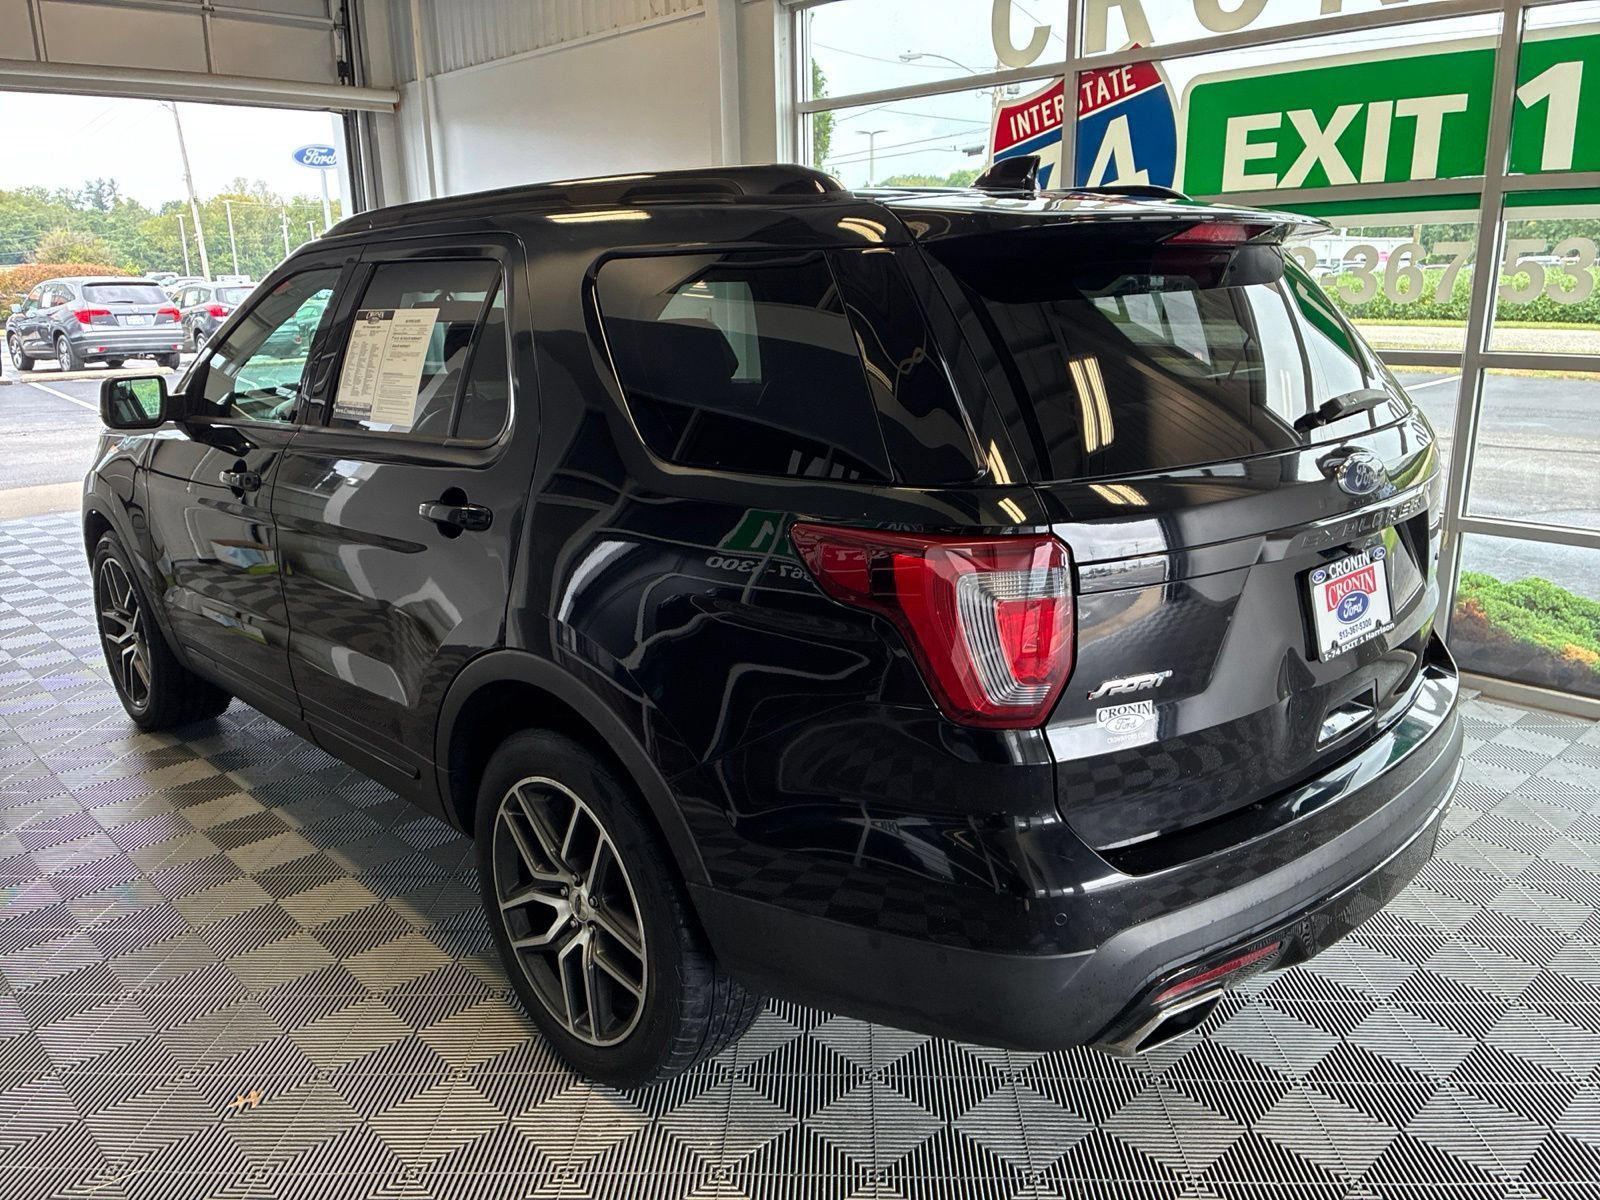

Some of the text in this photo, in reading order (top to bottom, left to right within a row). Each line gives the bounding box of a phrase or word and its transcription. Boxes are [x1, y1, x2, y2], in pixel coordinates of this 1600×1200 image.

[1009, 64, 1137, 142] INTERTATE
[1222, 61, 1584, 193] EXIT 1
[1354, 461, 1379, 488] Ford
[1302, 499, 1421, 547] EXPLORER
[1328, 551, 1371, 579] CRONIN
[1327, 569, 1377, 609] CRONIN
[1343, 595, 1363, 619] Ford
[1324, 646, 1341, 662] I-74
[1341, 639, 1359, 654] EXIT
[1365, 622, 1395, 641] Harrison
[1338, 618, 1373, 641] 513-367-5300
[1098, 701, 1151, 723] CRONIN
[1114, 716, 1137, 731] Ford
